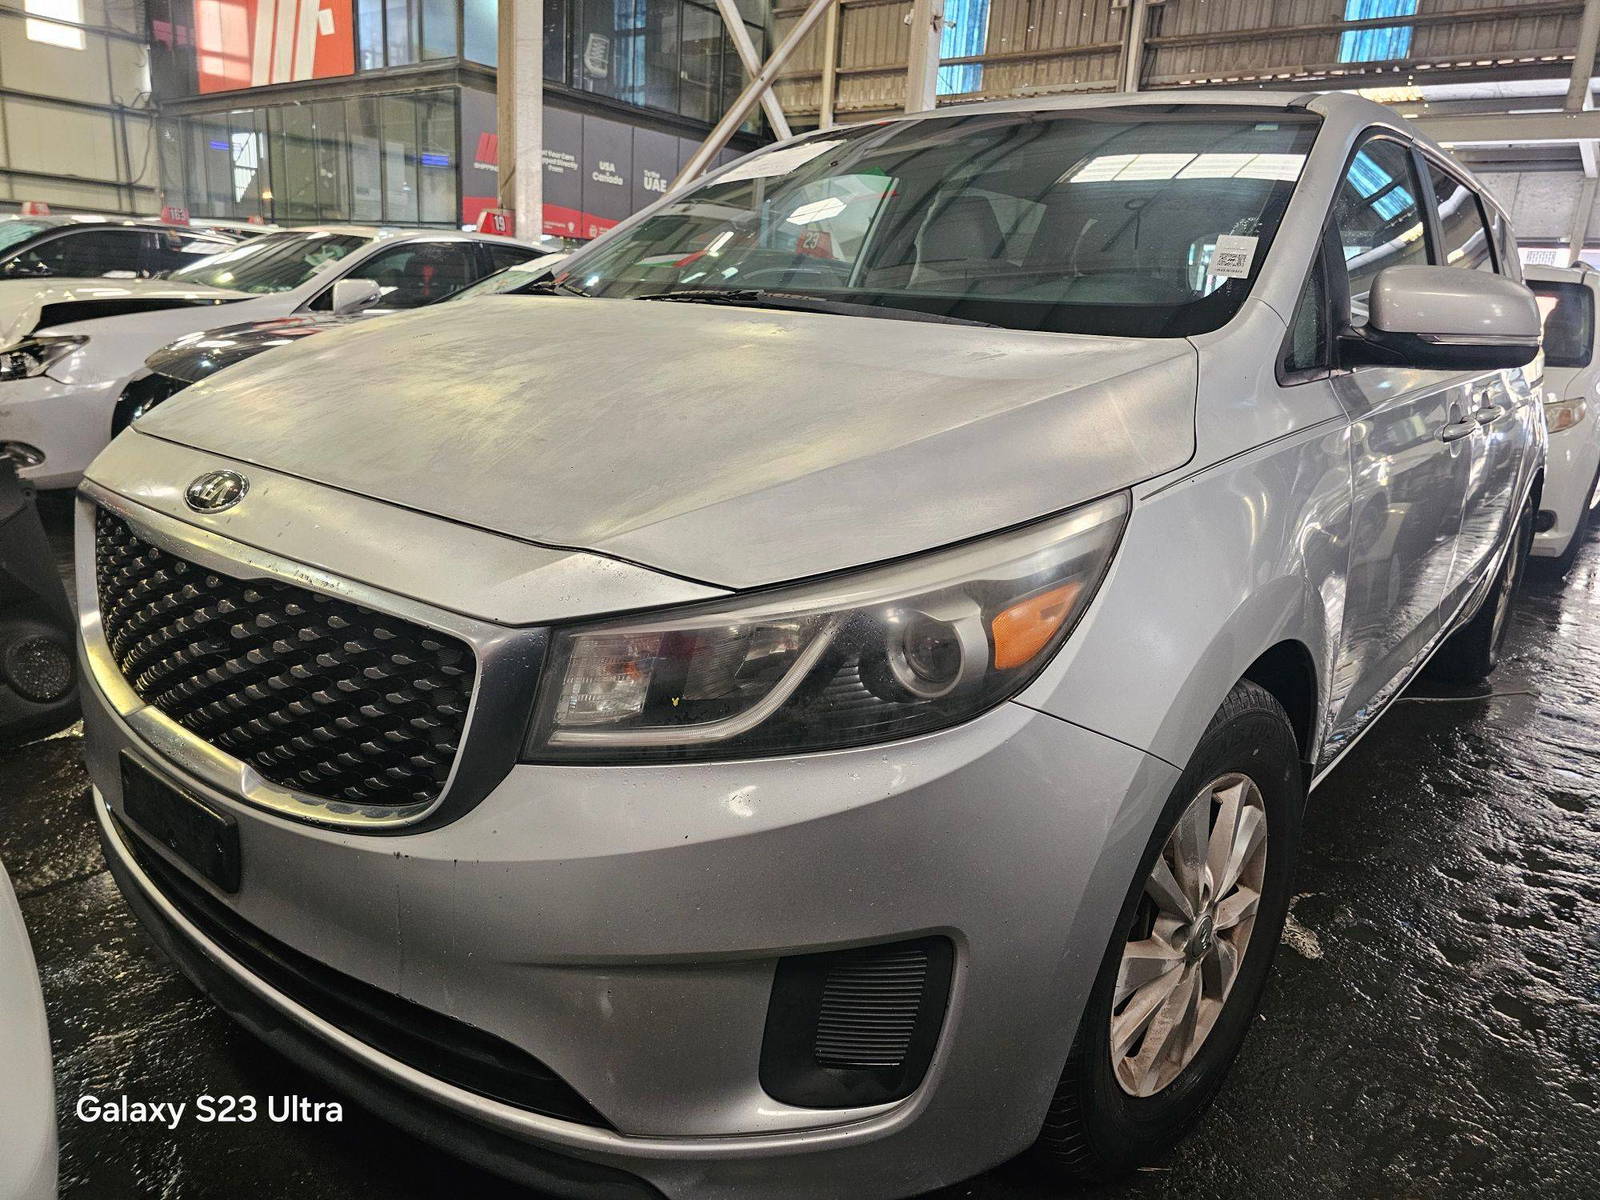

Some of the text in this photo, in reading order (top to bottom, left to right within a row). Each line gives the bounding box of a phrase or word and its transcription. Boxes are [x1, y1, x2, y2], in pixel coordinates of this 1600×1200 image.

[599, 160, 615, 173] USA
[592, 171, 624, 186] Canada
[644, 176, 668, 193] UAE
[494, 215, 506, 232] 19
